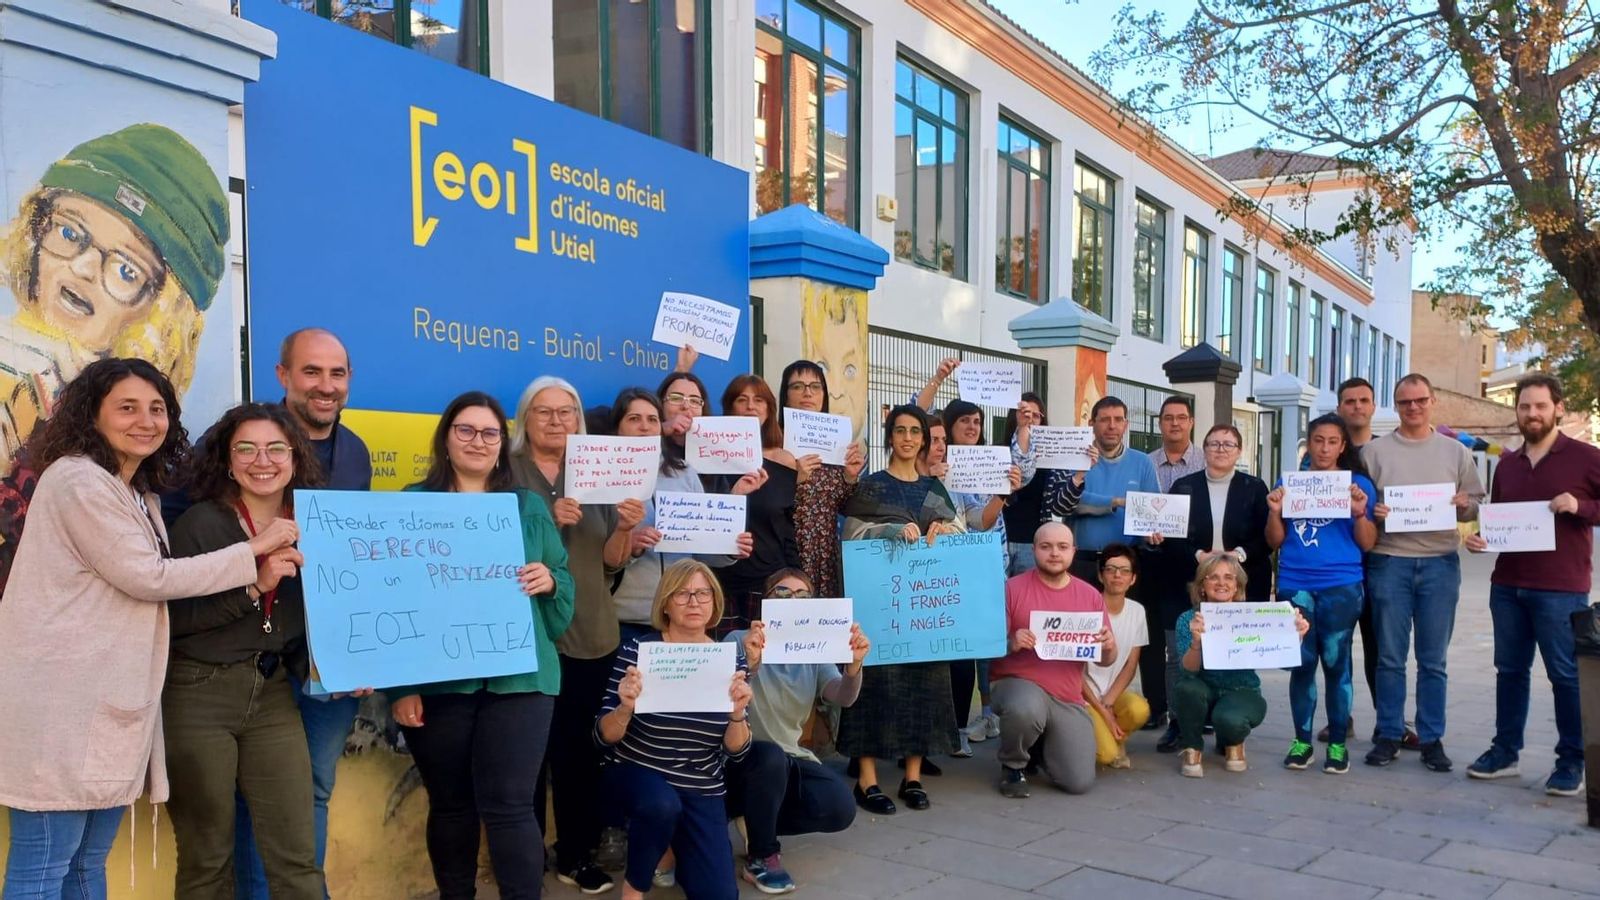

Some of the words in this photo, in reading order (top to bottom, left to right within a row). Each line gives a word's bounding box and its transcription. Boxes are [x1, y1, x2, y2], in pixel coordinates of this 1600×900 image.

[550, 162, 609, 195] escola
[616, 179, 666, 212] oficial
[551, 195, 639, 239] d'idiomes
[551, 230, 596, 263] Utiel
[679, 299, 733, 318] NECESITAMOS
[414, 307, 519, 352] Requena
[544, 327, 602, 362] Buñol
[622, 340, 669, 370] Chiva
[792, 412, 838, 425] APRENDER
[372, 452, 398, 463] LITAT
[1305, 485, 1333, 496] RIGHT
[1389, 490, 1404, 498] Los
[659, 496, 670, 505] No
[1132, 496, 1147, 507] WE
[1291, 498, 1308, 512] NOT
[400, 511, 454, 531] idiomas
[349, 537, 452, 562] DERECHO
[908, 558, 941, 576] grups
[317, 563, 359, 594] NO
[385, 575, 402, 587] un
[426, 563, 523, 592] PRIVILEGI
[908, 574, 960, 592] VALENCIÀ
[910, 591, 961, 610] FRANCÉS
[769, 620, 783, 629] POR
[794, 618, 810, 626] UNA
[910, 613, 955, 631] ANGLÉS
[1043, 617, 1061, 630] NO
[1063, 617, 1074, 630] A
[1078, 617, 1099, 630] LAS
[348, 610, 425, 653] EOI
[1046, 632, 1100, 644] RECORTES
[442, 622, 532, 660] UTIEL
[877, 642, 912, 660] EOI
[929, 637, 974, 654] UTIEL
[1042, 644, 1058, 657] EN
[1059, 645, 1073, 658] LA
[1076, 646, 1096, 658] EOI
